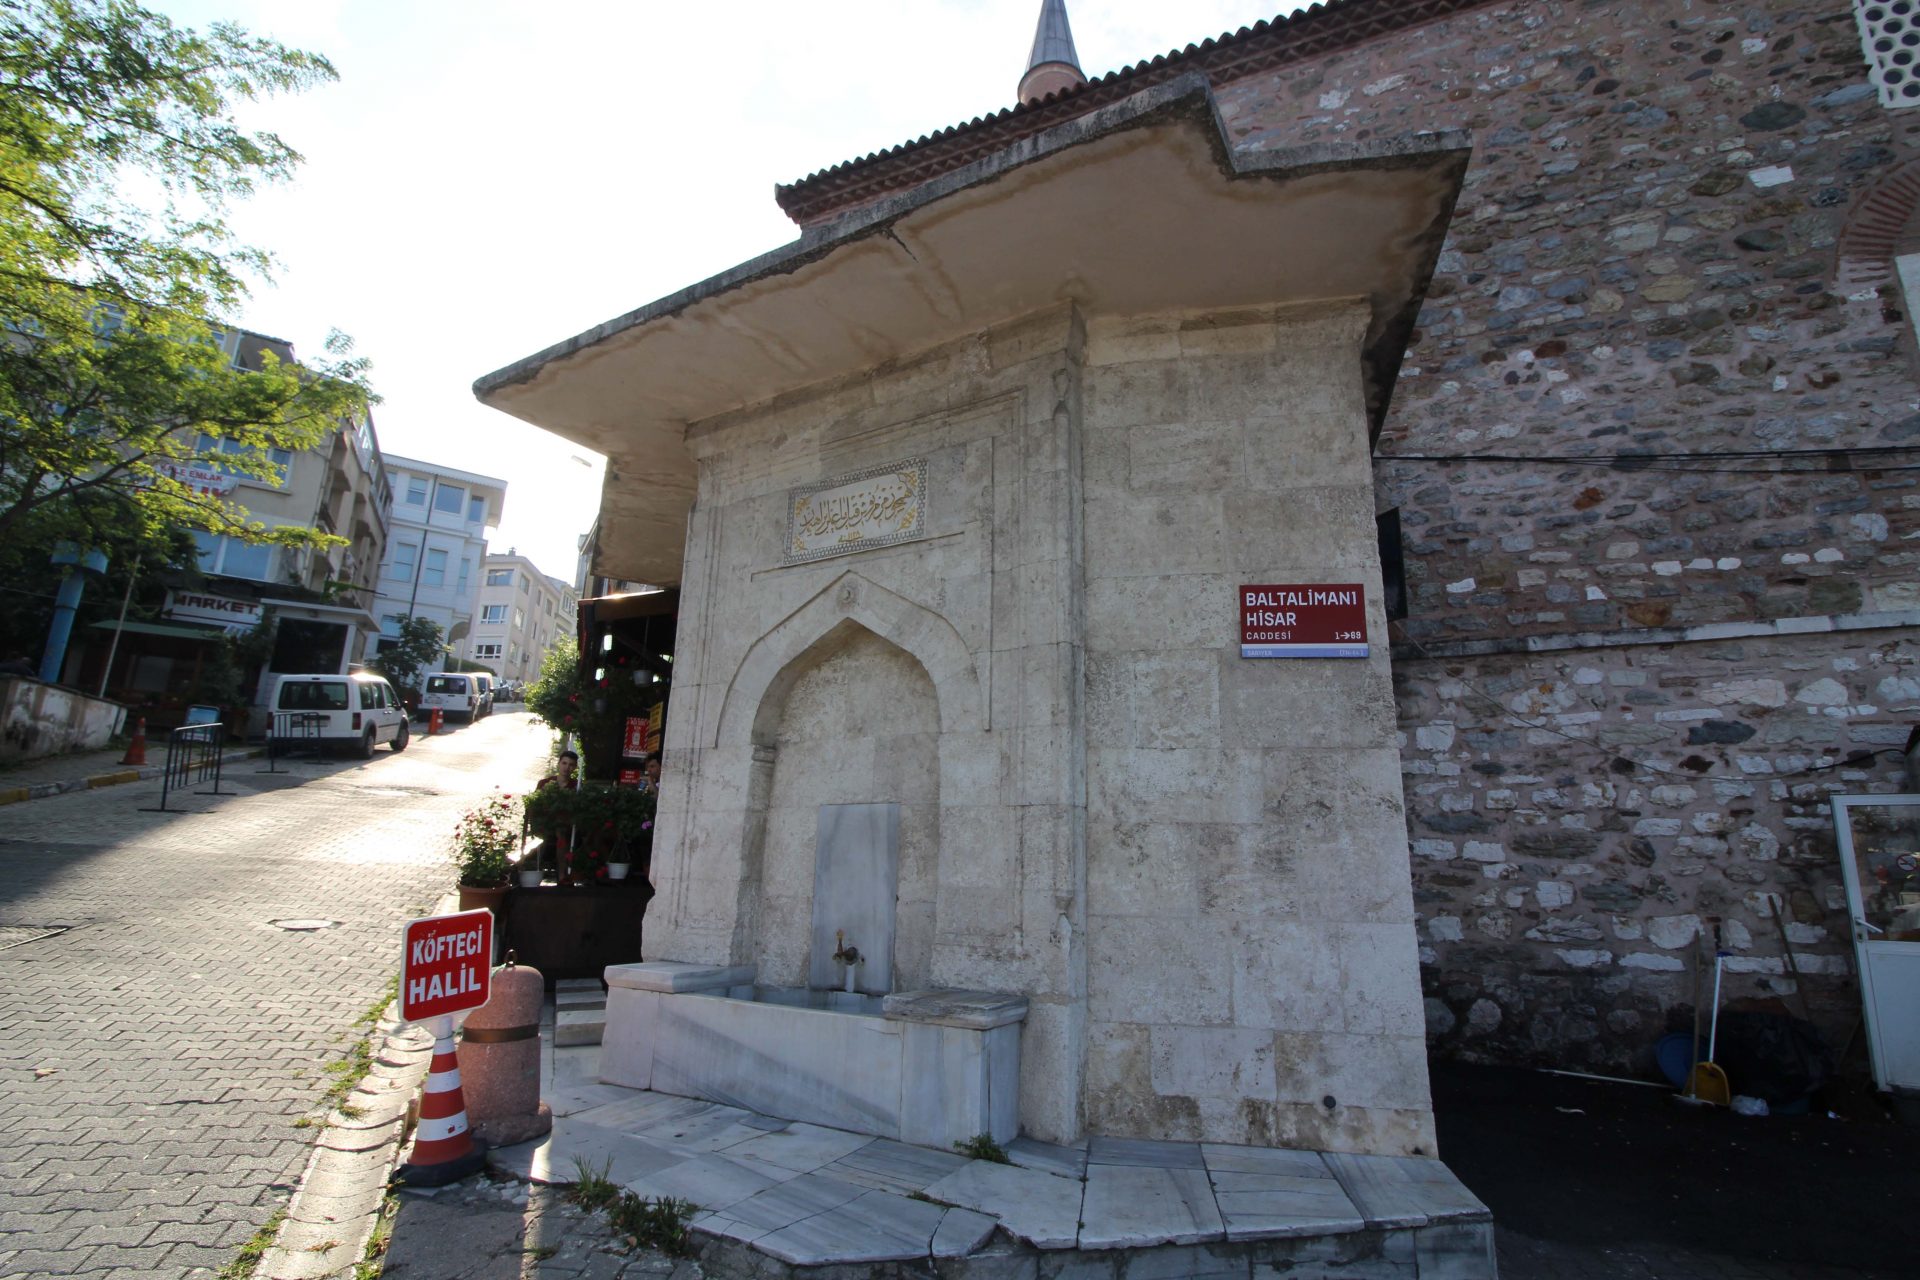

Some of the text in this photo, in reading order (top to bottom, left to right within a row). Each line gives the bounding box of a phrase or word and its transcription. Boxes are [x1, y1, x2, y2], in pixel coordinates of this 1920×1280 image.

[189, 469, 224, 482] EMLAK
[1246, 589, 1357, 607] BALTALİMANI
[1246, 609, 1297, 627] HİSAR
[1246, 630, 1292, 641] CADDESİ
[412, 924, 483, 966] KÖFTECİ
[409, 963, 481, 1005] HALİL
